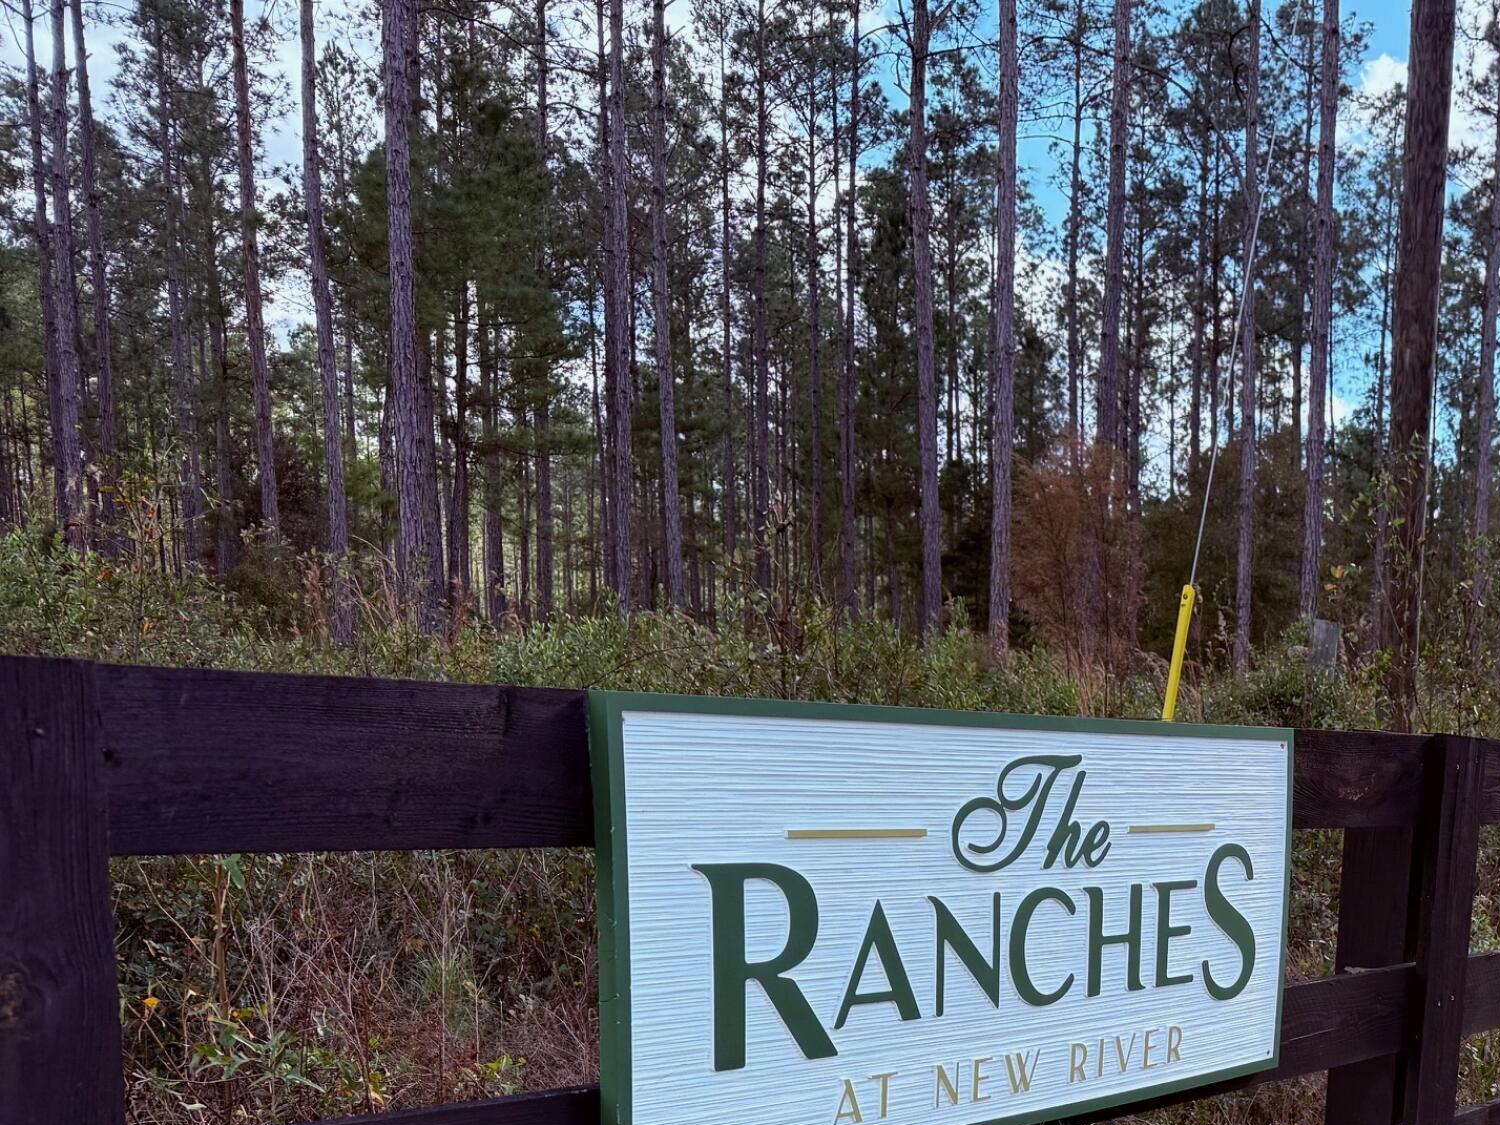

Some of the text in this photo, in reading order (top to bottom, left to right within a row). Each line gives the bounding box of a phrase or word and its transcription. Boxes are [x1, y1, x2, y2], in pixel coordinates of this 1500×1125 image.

[951, 754, 1111, 873] The
[691, 843, 1256, 1071] RANCHES
[832, 1025, 1183, 1125] AT NEW RIVER
